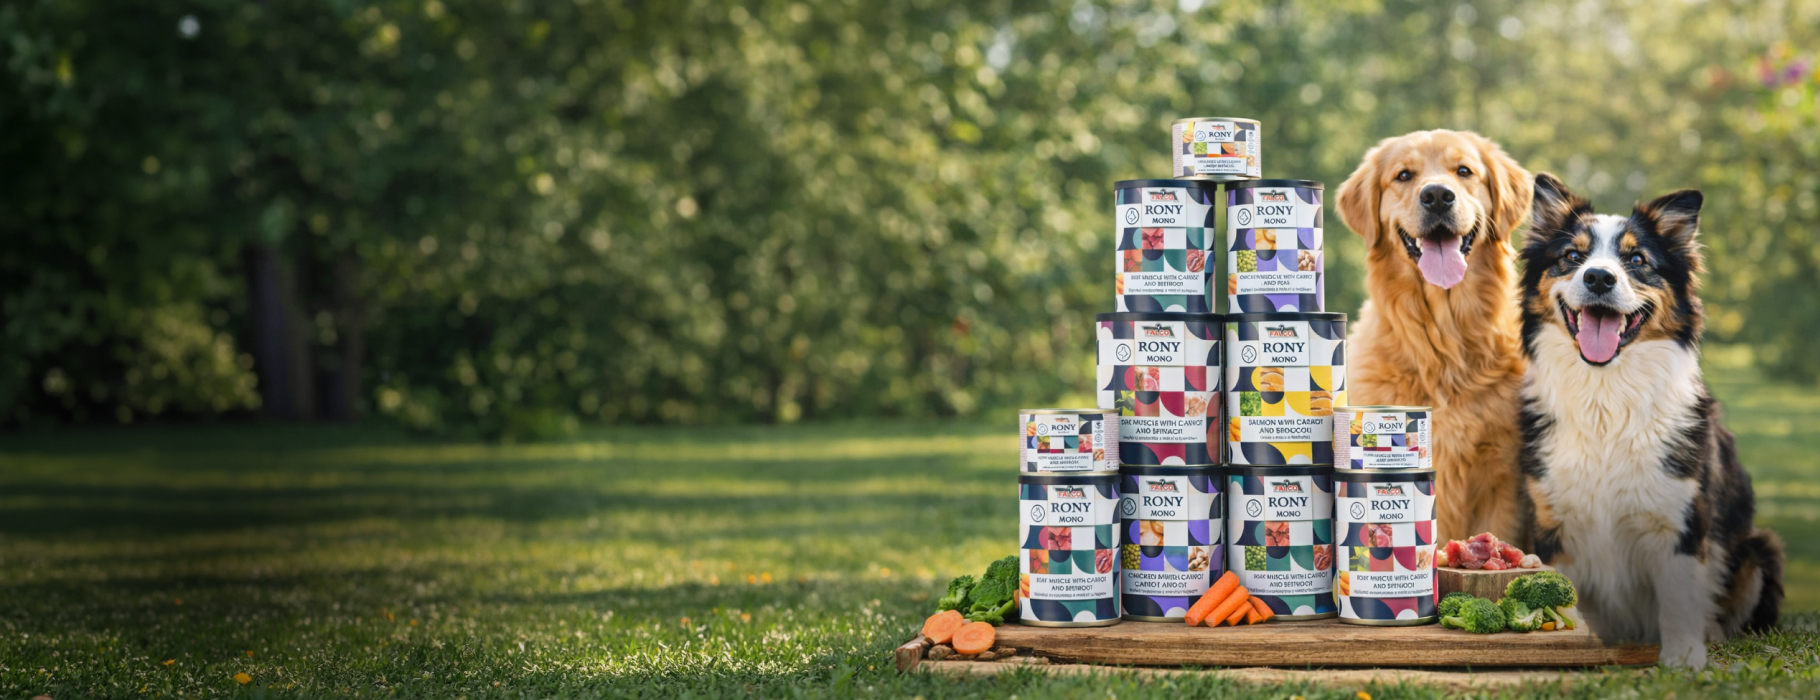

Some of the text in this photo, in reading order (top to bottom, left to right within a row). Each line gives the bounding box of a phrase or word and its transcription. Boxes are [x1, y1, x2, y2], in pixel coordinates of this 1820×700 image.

[1144, 205, 1183, 215] RONY
[1256, 205, 1294, 216] RONY
[1138, 341, 1181, 353] RONY
[1262, 342, 1306, 353] RONY
[1142, 496, 1184, 507] RONY
[1268, 497, 1308, 508] RONY
[1370, 500, 1411, 510] RONY
[1050, 502, 1092, 513] RONY
